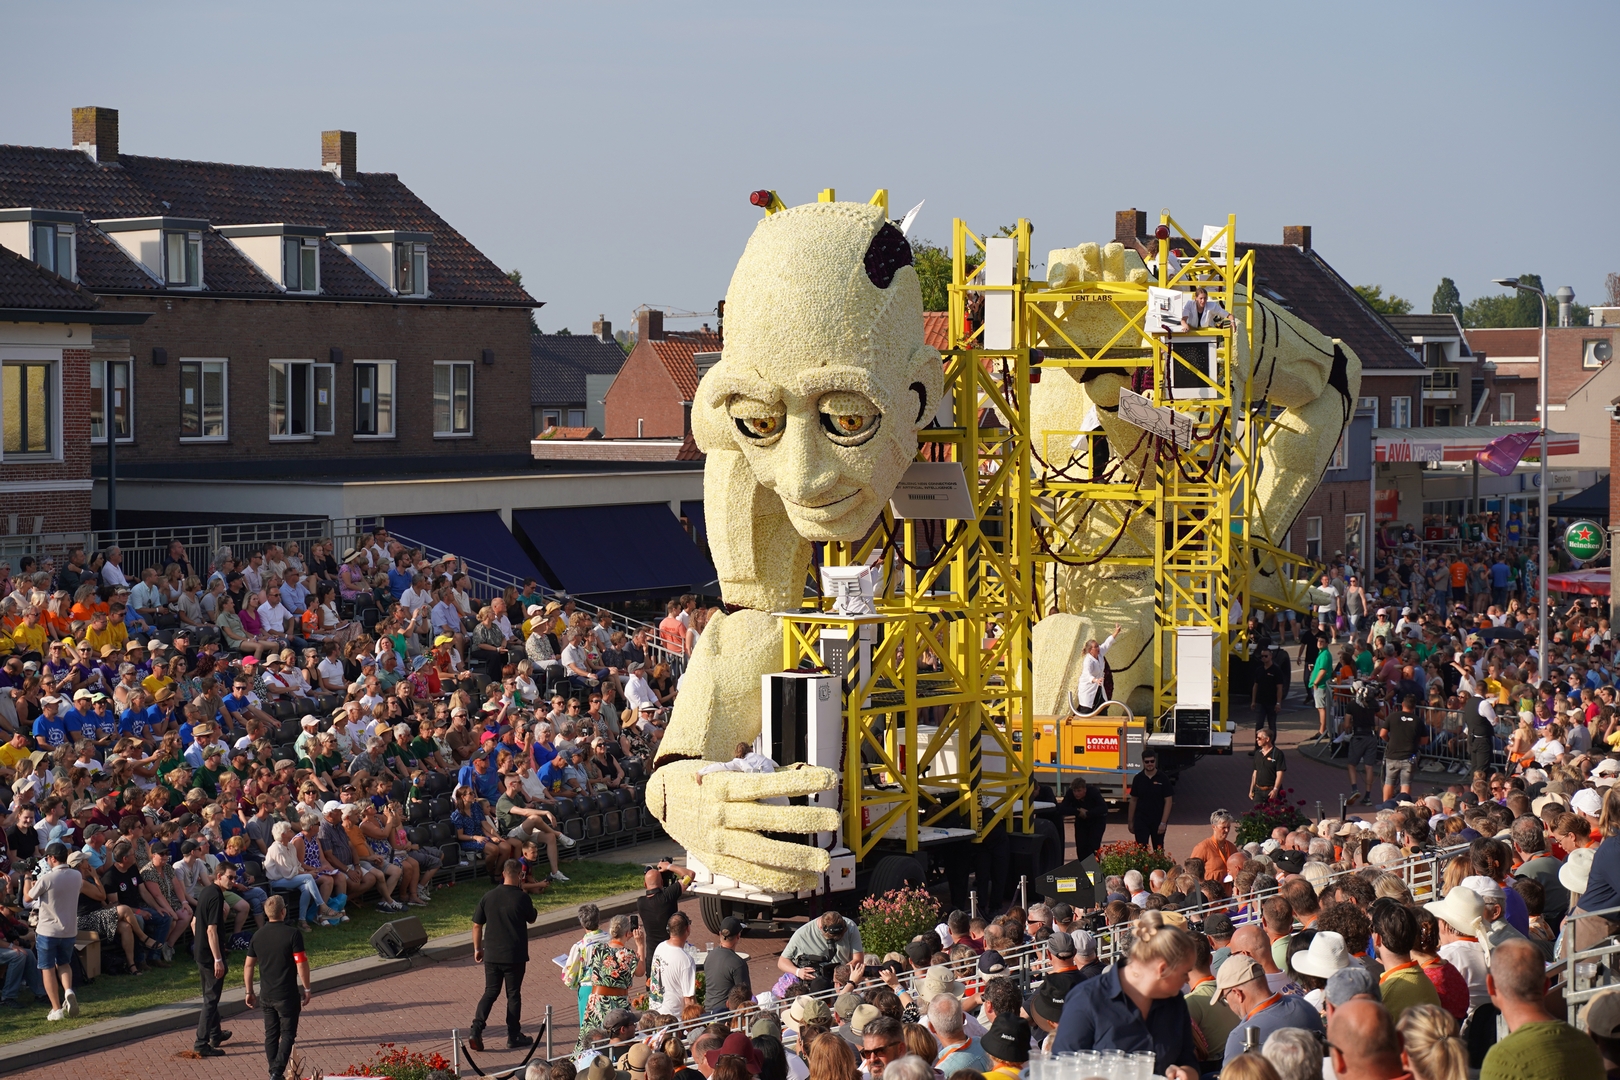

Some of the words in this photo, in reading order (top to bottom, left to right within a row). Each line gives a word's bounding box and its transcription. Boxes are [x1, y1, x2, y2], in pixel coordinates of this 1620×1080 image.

[1071, 294, 1090, 302] LENT
[1092, 294, 1113, 302] LABS
[1413, 445, 1440, 462] XPress
[1554, 474, 1572, 484] Service
[1431, 530, 1438, 539] 2
[1568, 540, 1601, 550] Heineken
[1086, 737, 1118, 745] LOXAM
